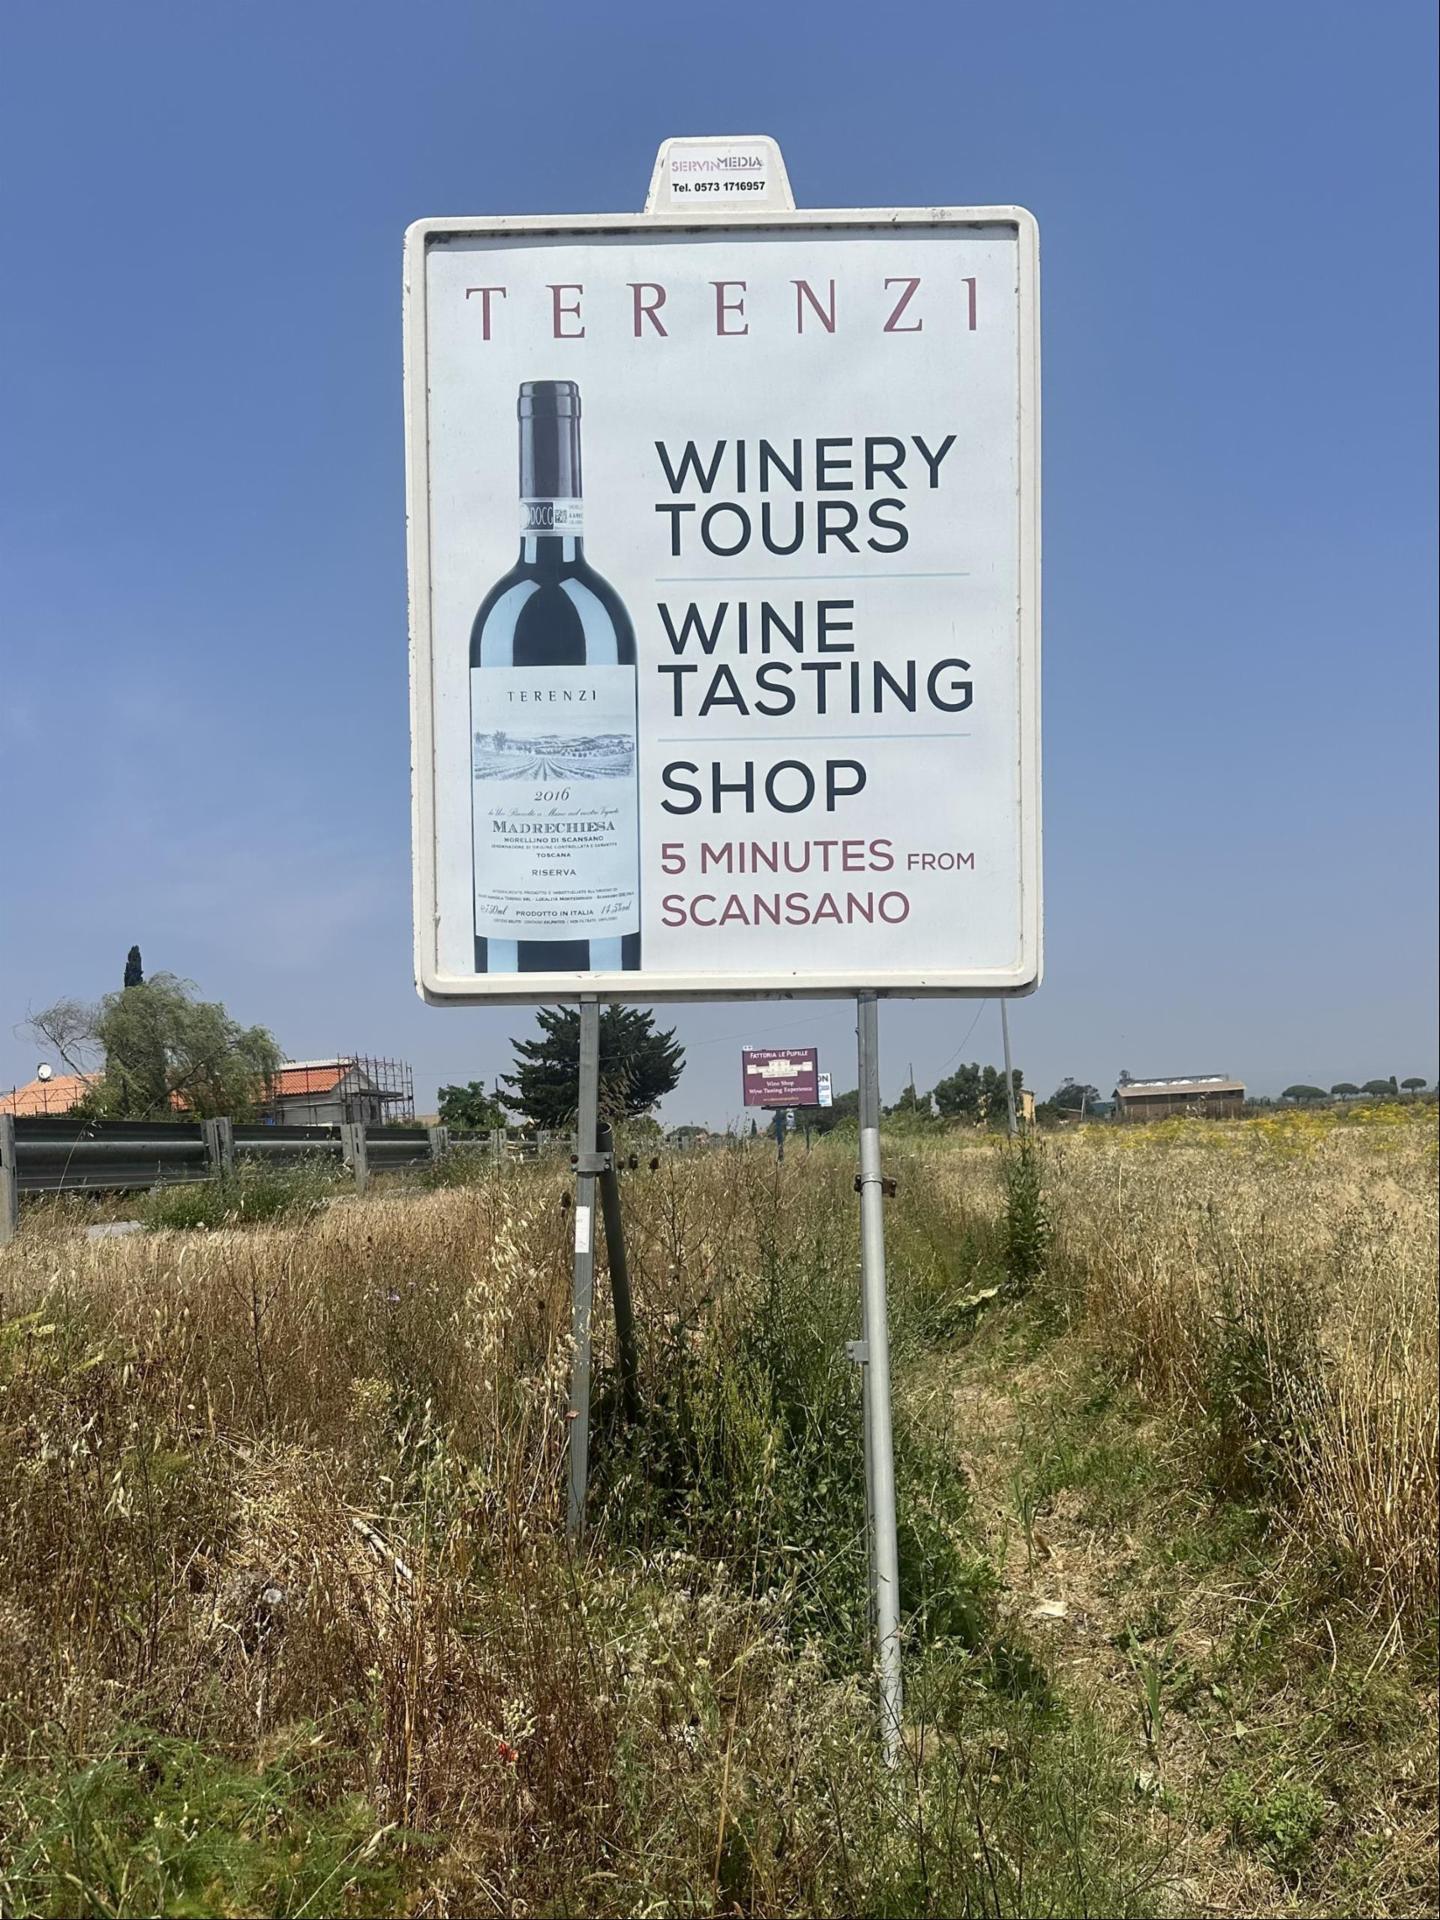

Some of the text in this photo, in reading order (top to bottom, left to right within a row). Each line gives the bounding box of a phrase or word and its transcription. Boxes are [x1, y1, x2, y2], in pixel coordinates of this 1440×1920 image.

[672, 181, 766, 192] Tel. 0573 1716957
[465, 277, 978, 341] TERENZI
[654, 435, 957, 494] WINERY
[655, 498, 909, 557] TOURS
[657, 600, 855, 655] WINE
[507, 690, 597, 702] TERENZI
[657, 658, 973, 717] TASTING
[534, 786, 571, 802] 2016
[661, 760, 867, 815] SHOP
[492, 820, 616, 834] MADRECHIESA
[661, 839, 975, 875] 5 MINUTES FROM
[661, 891, 910, 927] SCANSANO
